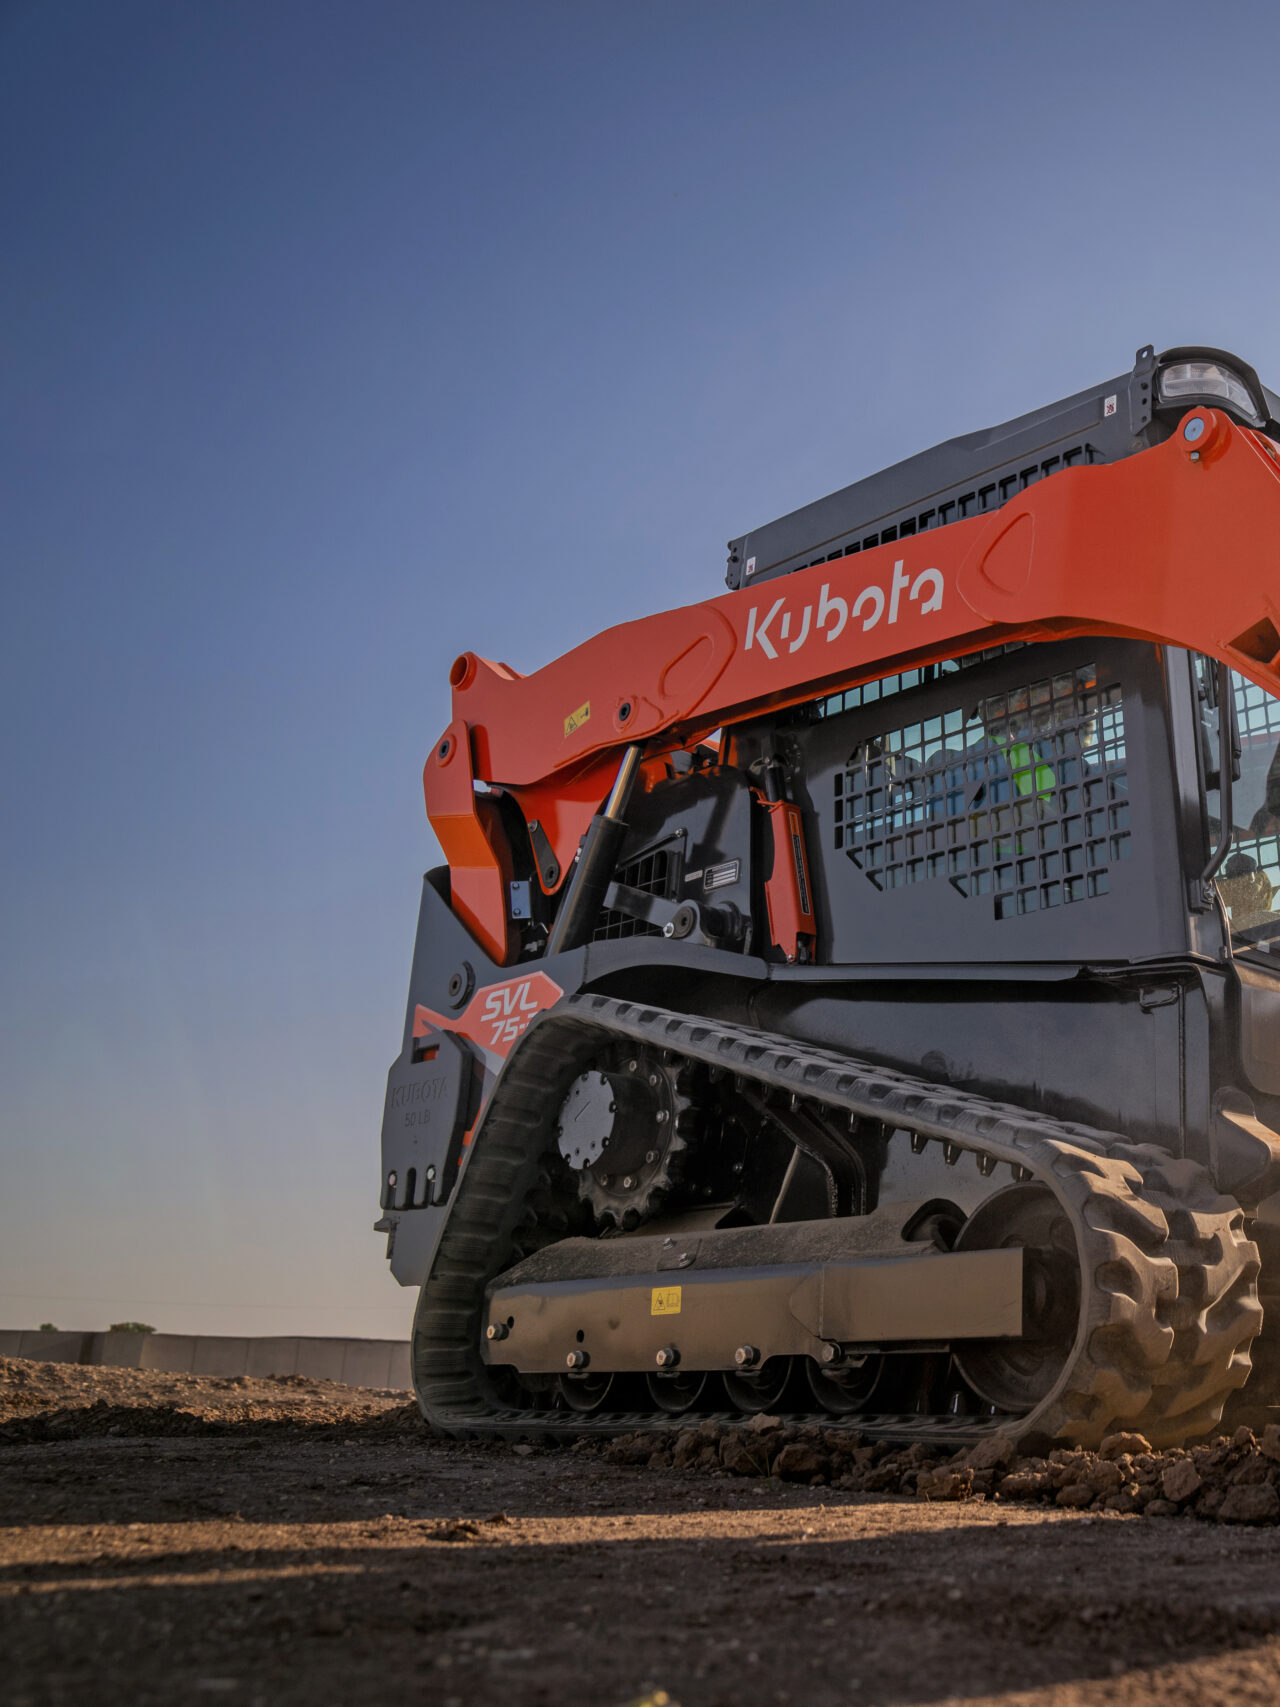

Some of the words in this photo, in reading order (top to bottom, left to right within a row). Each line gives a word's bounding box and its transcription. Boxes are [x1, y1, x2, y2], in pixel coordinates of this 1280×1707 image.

[744, 559, 944, 660] Kubota
[480, 982, 538, 1022] SVL
[490, 1011, 538, 1045] 75-
[391, 1076, 449, 1109] KUBOTA
